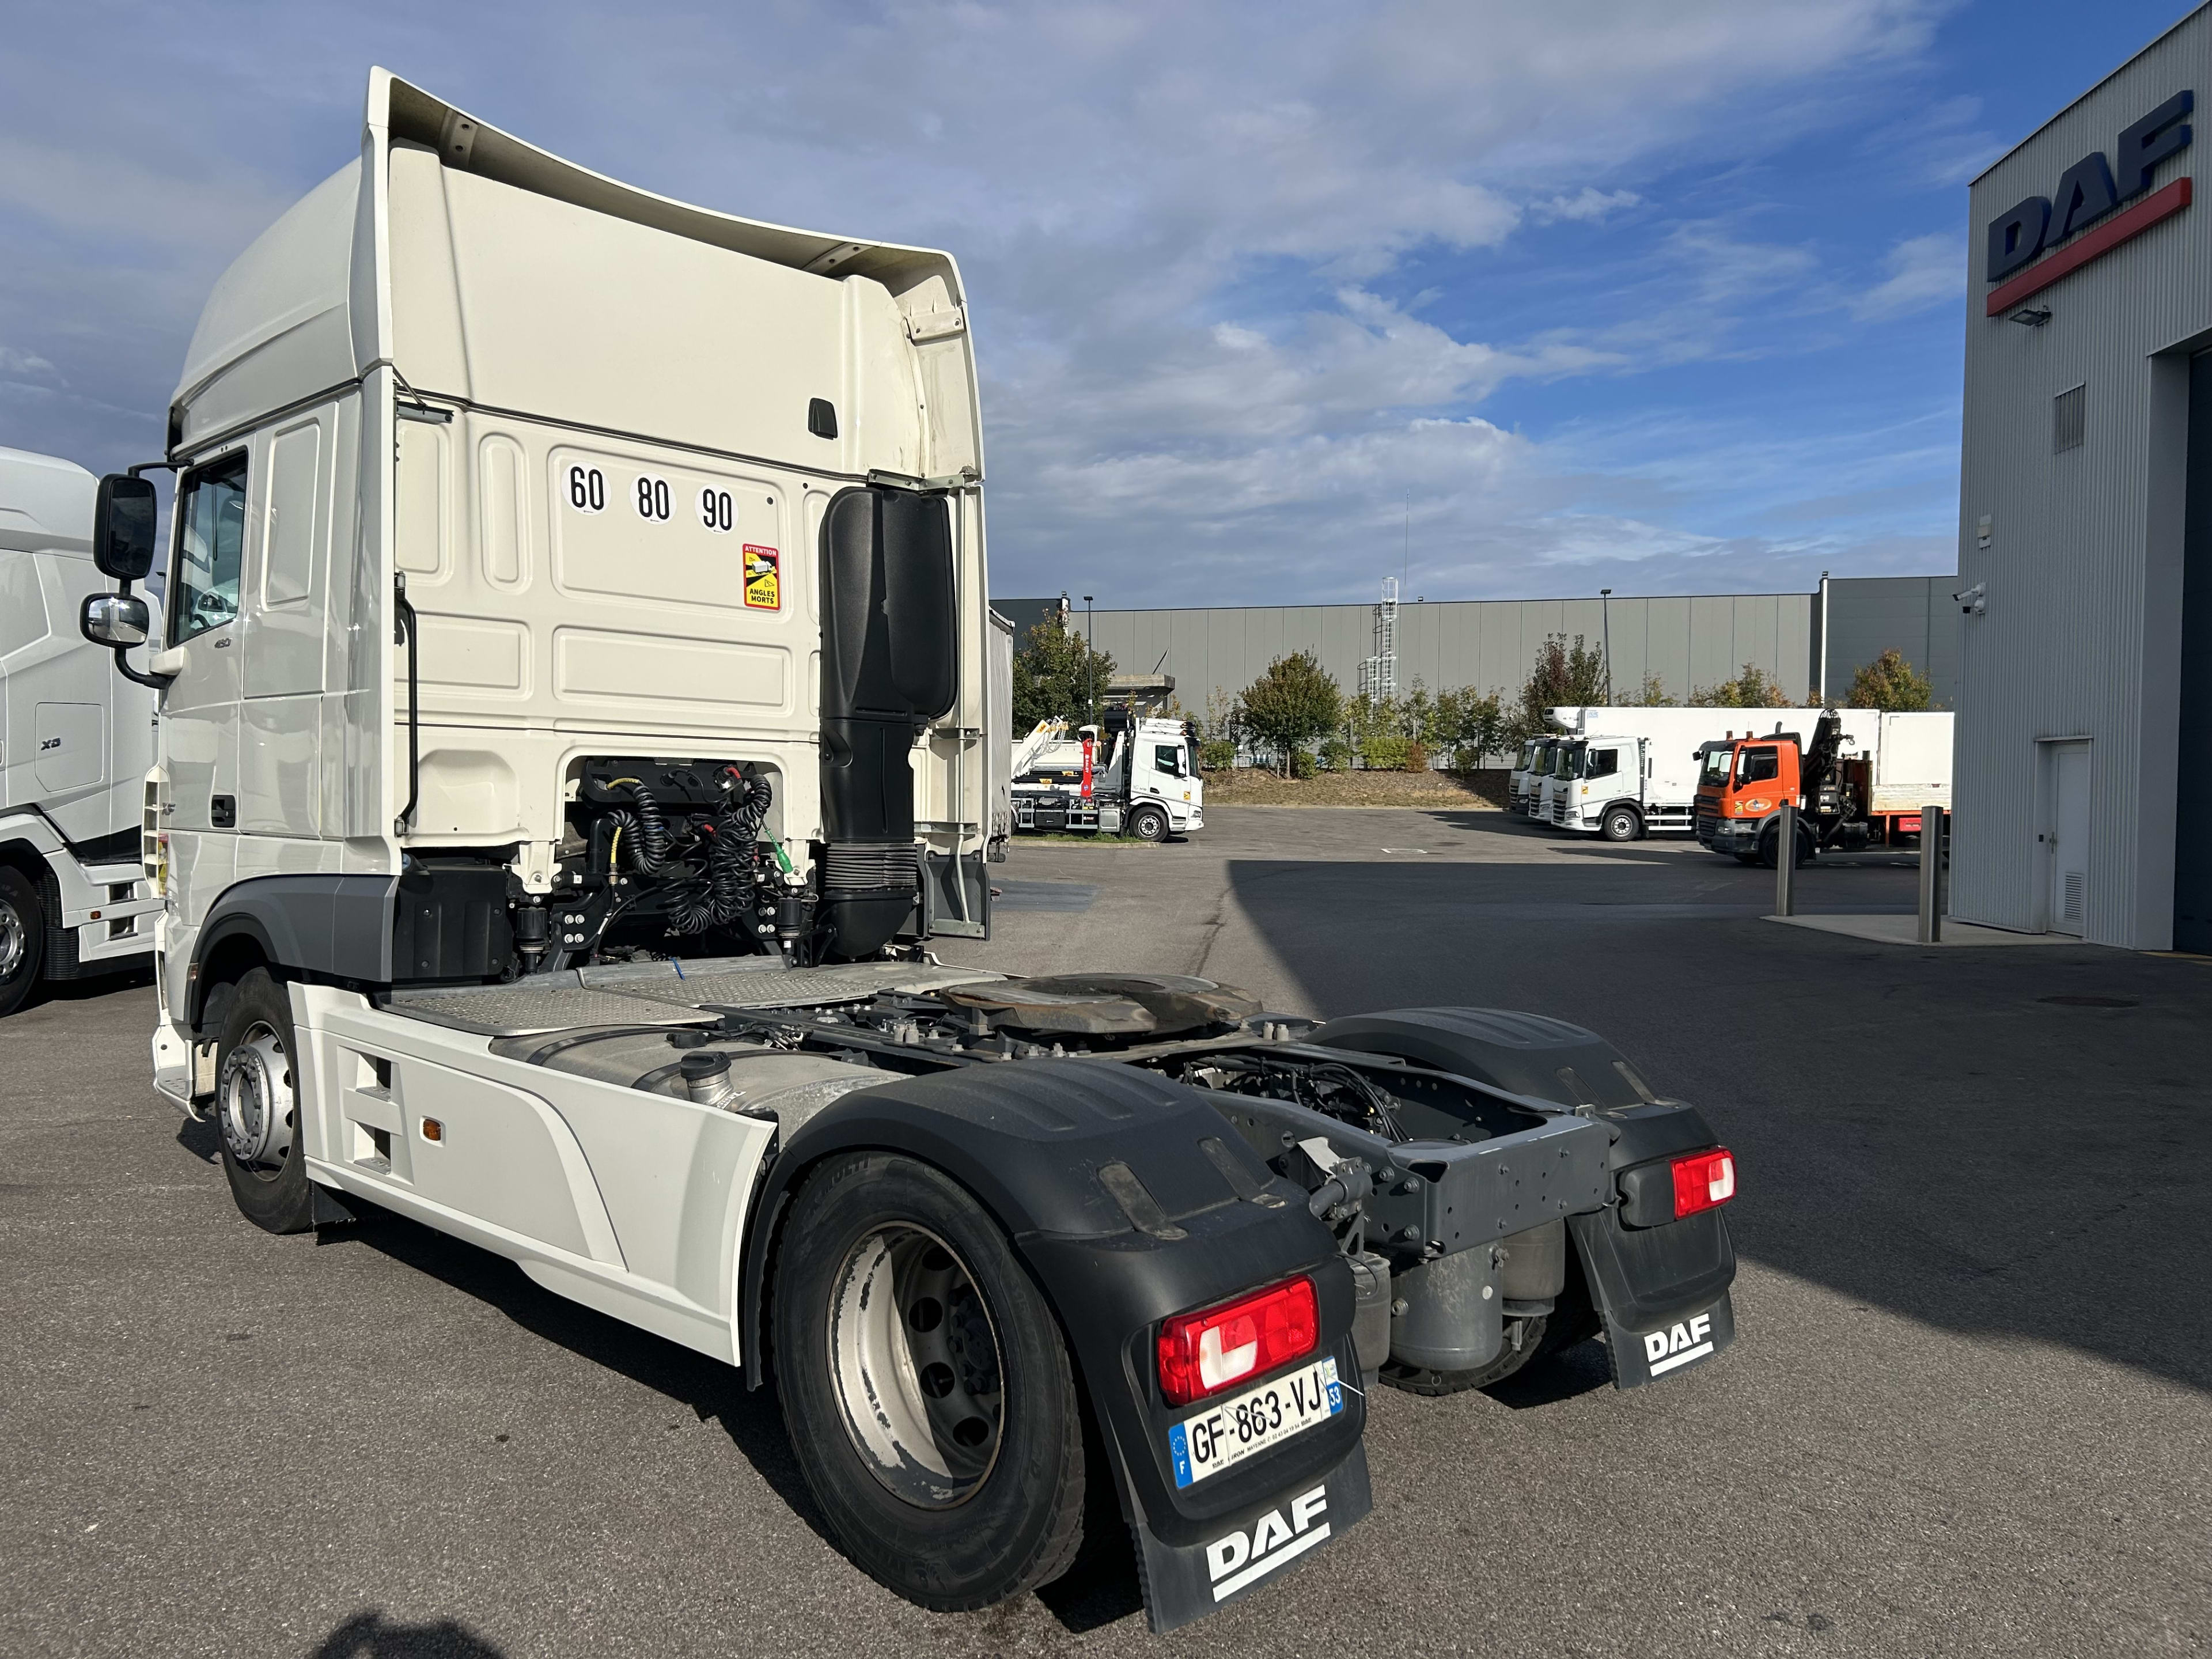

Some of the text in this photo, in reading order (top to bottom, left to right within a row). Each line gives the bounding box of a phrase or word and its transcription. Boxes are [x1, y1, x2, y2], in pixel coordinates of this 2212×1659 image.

[1987, 90, 2194, 282] DAF
[570, 466, 604, 511] 60
[638, 477, 669, 520] 80
[703, 488, 732, 531] 90
[745, 546, 777, 556] ATTENTION
[749, 588, 775, 597] ANGLES
[751, 595, 774, 604] MORTS
[1644, 1313, 1711, 1362] DAF
[1192, 1371, 1342, 1464] GF-863-VJ 53
[1179, 1461, 1185, 1475] F
[1207, 1484, 1327, 1582] DAF
